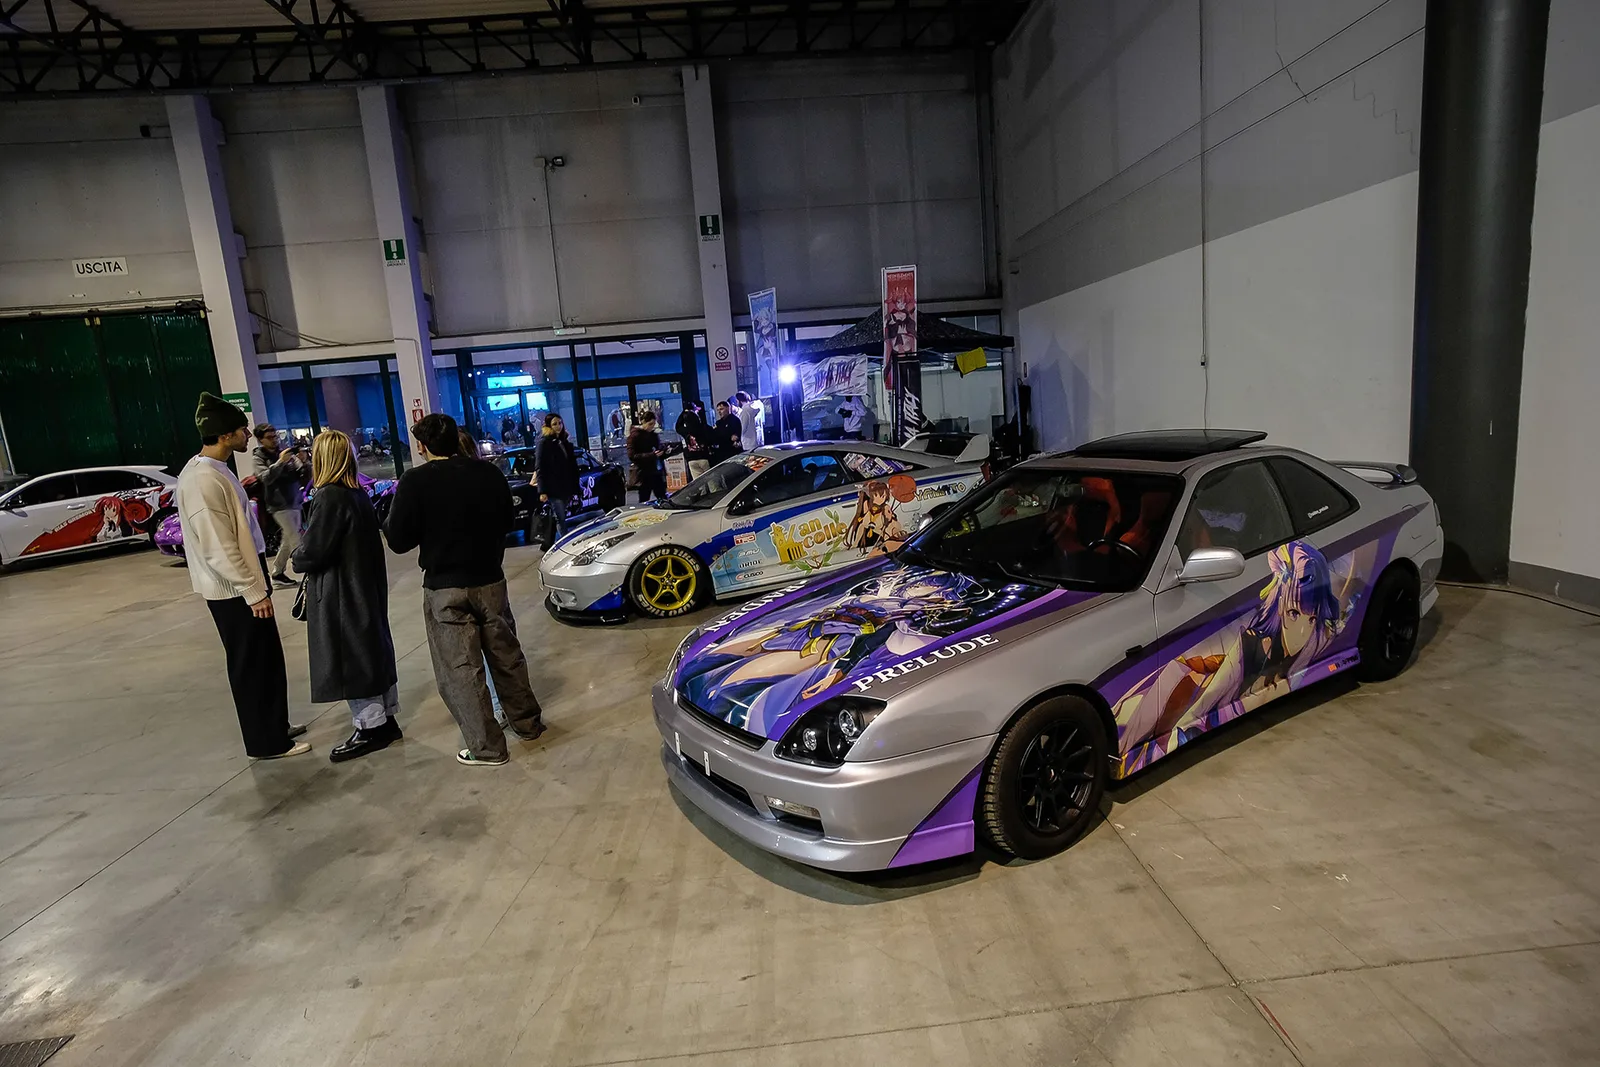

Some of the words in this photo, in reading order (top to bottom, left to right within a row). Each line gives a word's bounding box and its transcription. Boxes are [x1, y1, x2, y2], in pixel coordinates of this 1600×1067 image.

[76, 261, 123, 275] USCITA
[903, 386, 920, 426] ITALY
[913, 481, 967, 501] YAMATO
[642, 548, 670, 566] TOYO
[673, 548, 700, 572] TIRES
[852, 633, 999, 693] PRELUDE
